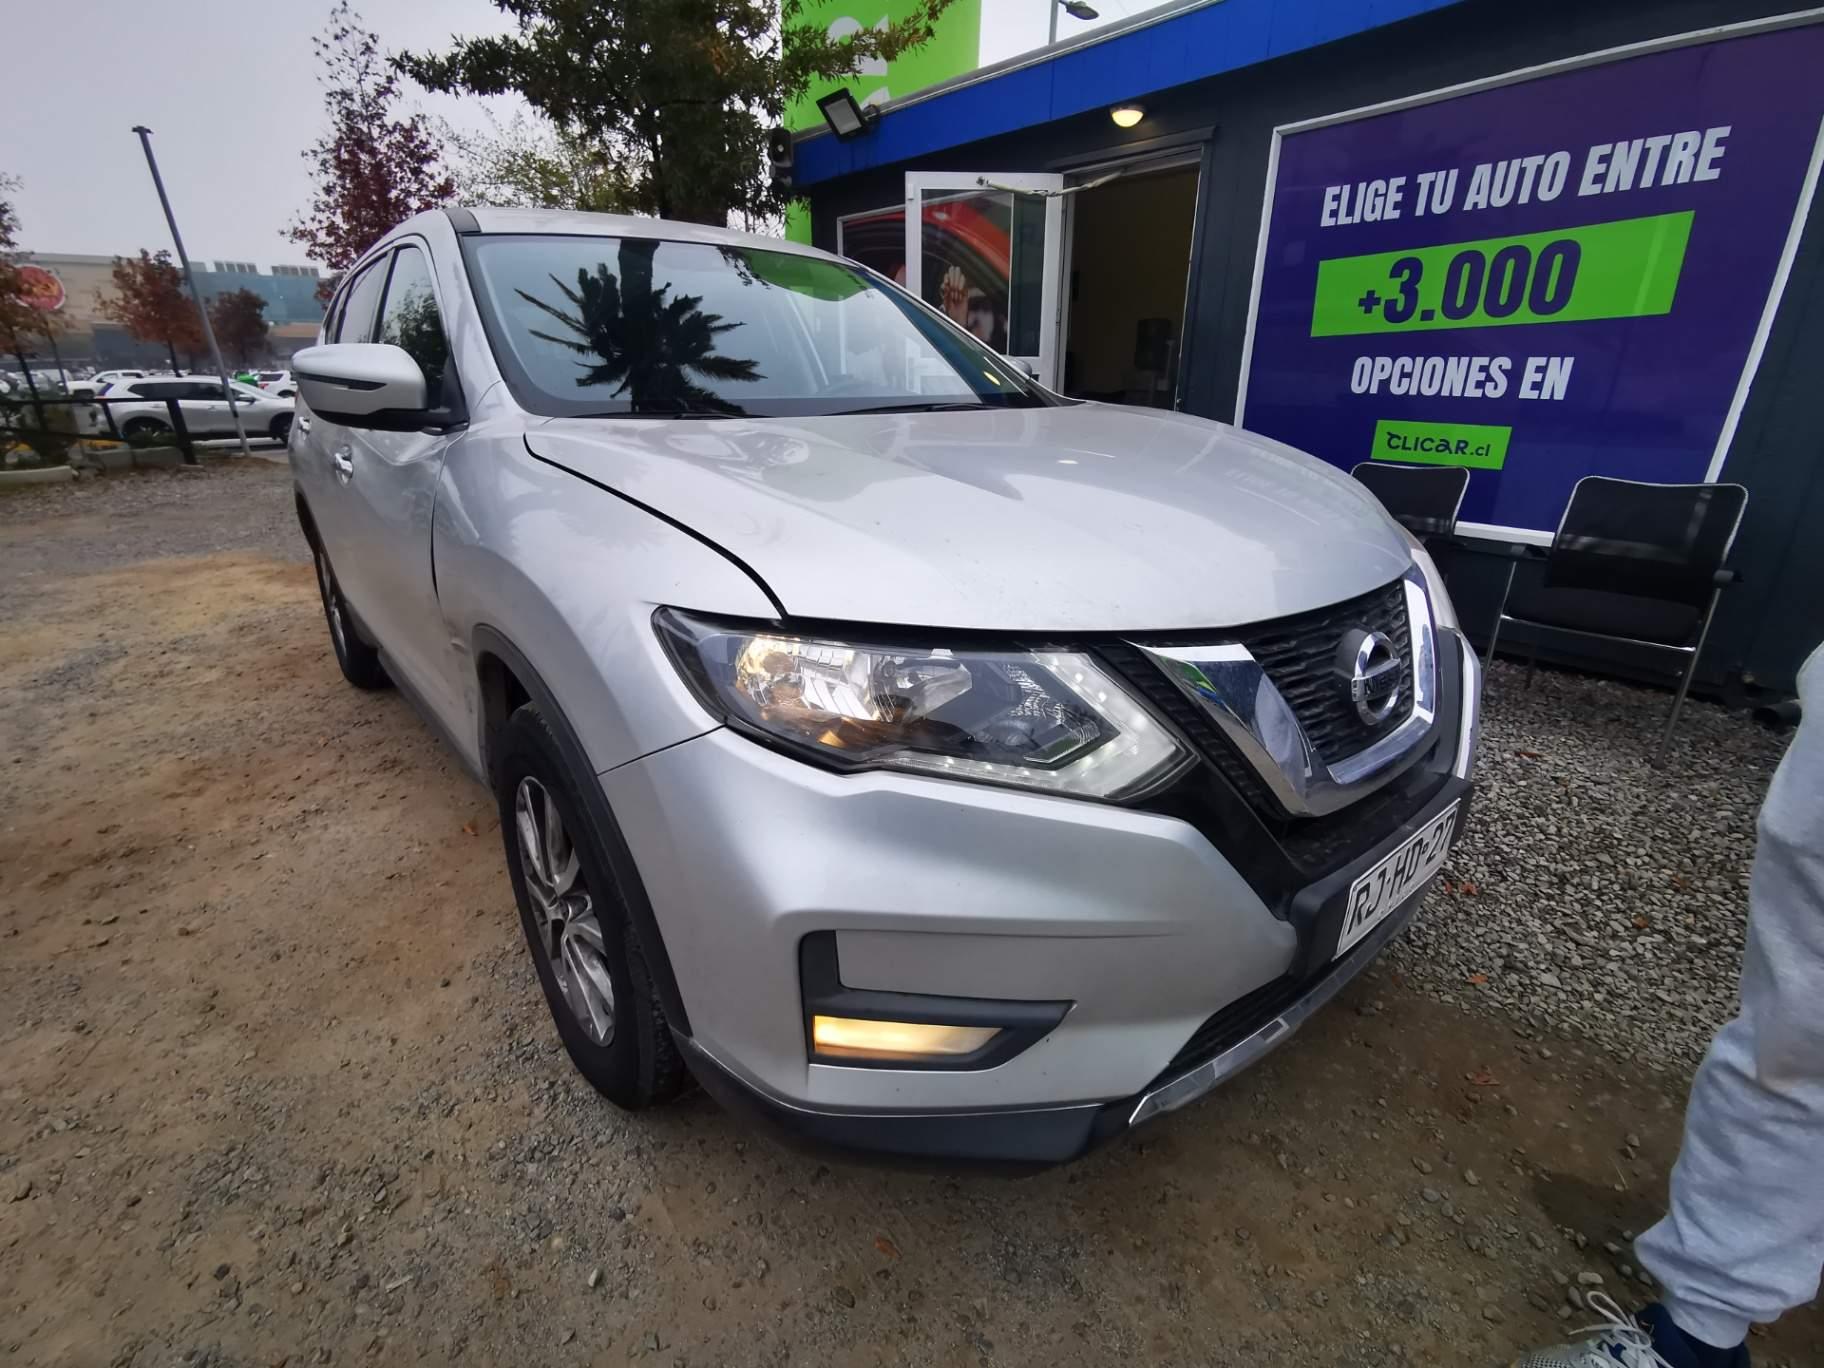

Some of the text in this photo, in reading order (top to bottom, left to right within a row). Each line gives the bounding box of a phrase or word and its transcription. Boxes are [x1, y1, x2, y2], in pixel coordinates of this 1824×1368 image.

[1321, 126, 1731, 226] ELIGE TU AUTO ENTRE
[1358, 239, 1581, 323] +3.000
[1351, 356, 1574, 400] OPCIONES EN
